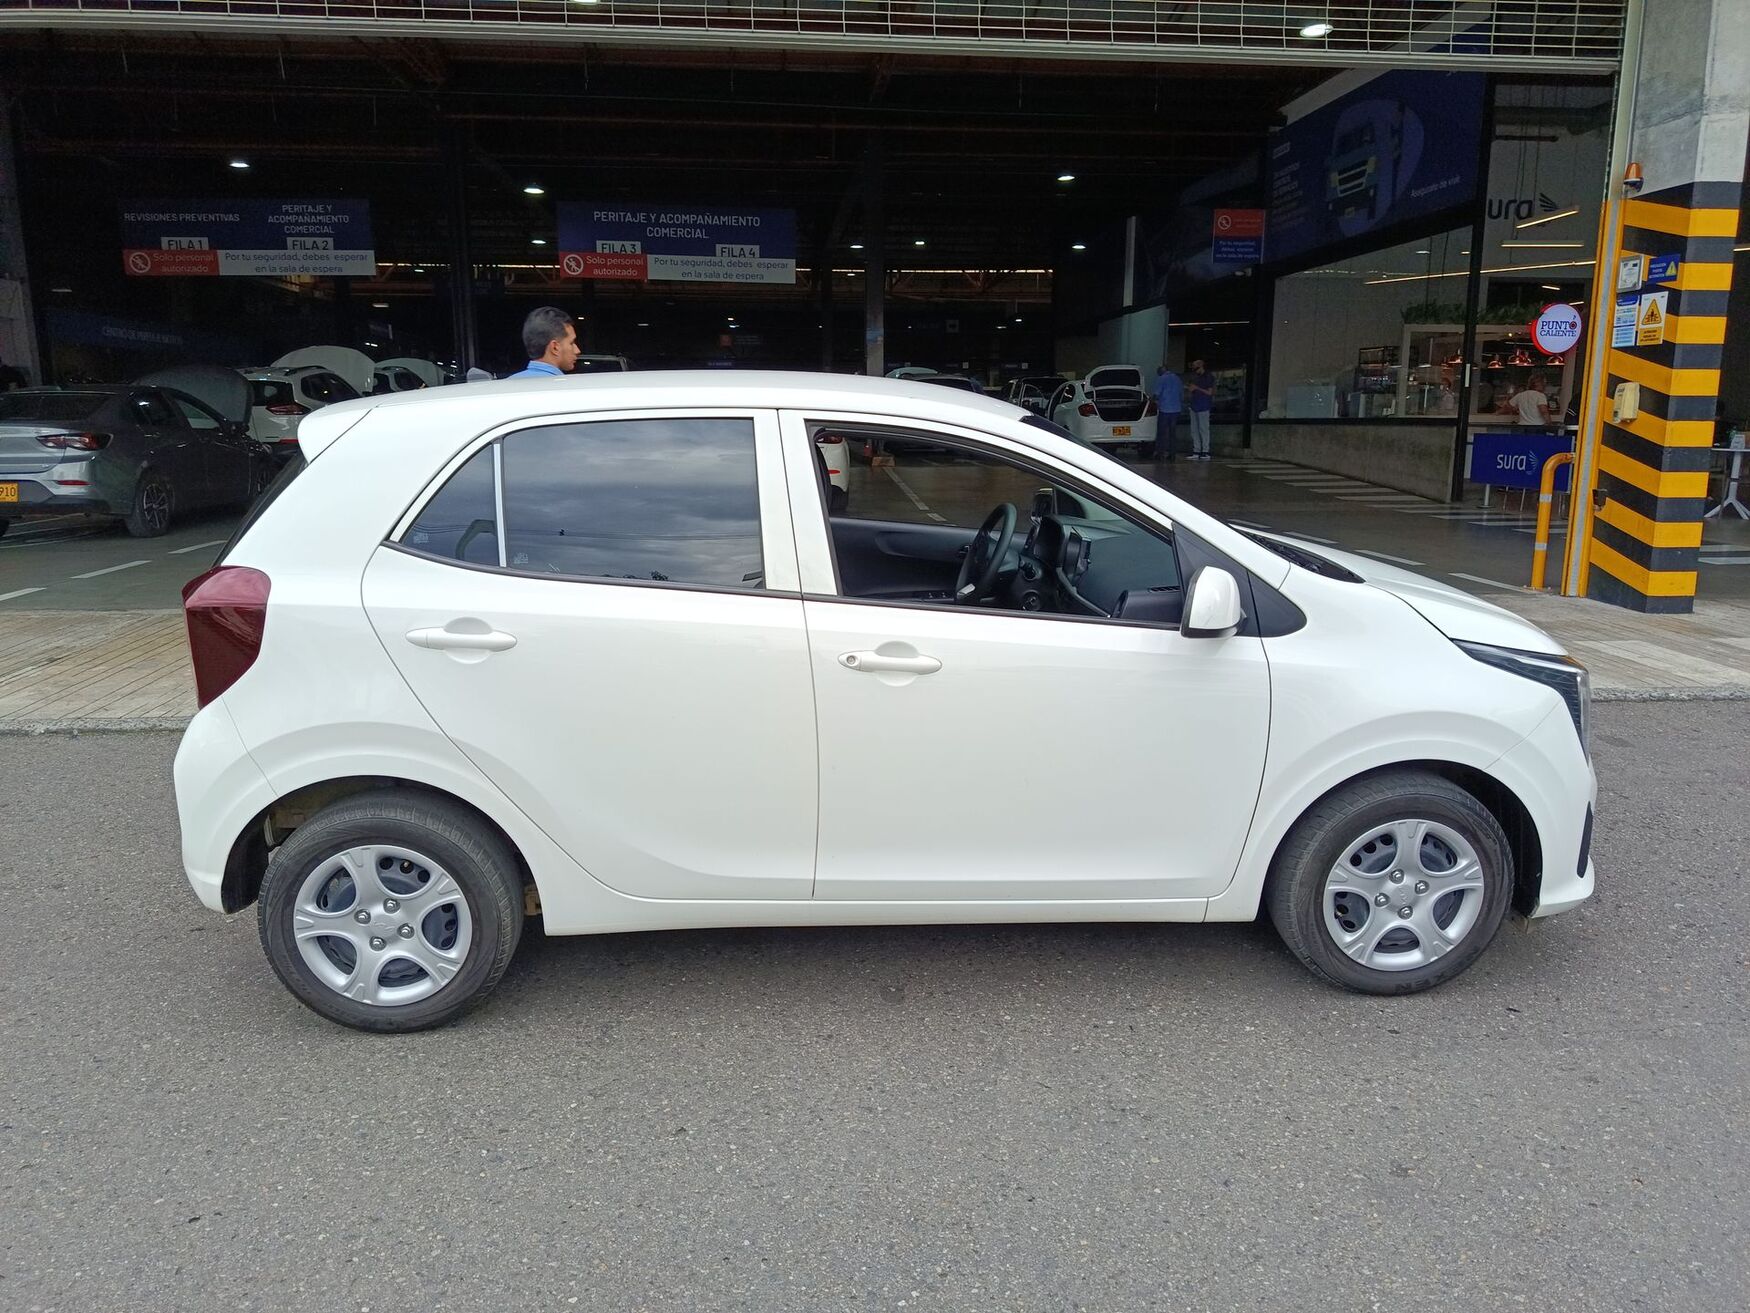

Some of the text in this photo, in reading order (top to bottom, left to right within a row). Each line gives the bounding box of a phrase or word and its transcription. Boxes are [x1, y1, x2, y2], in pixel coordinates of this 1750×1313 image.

[282, 204, 333, 213] PERITAJE Y
[1487, 199, 1533, 220] ura
[123, 212, 241, 222] REVISIONES PREVENTIVAS
[268, 213, 350, 224] ACOMPAÑAMIENTO
[593, 210, 761, 227] PERITAJE Y ACOMPAÑAMIENTO
[284, 225, 336, 234] COMERCIAL
[646, 226, 710, 239] COMERCIAL
[167, 239, 195, 250] FILA
[292, 239, 329, 250] FILA 2
[601, 243, 637, 254] FILA 3
[225, 252, 240, 261] Por
[241, 253, 250, 261] tu
[302, 252, 330, 261] debes
[333, 253, 368, 263] esperar
[720, 246, 756, 258] FILA 4
[153, 253, 215, 263] Solo personal
[586, 255, 644, 267] Solo personal
[160, 264, 208, 273] autorizado
[255, 264, 343, 274] en la sala de espera
[654, 257, 788, 271] Por tu seguridad, debes esperar
[593, 267, 638, 276] autorizado
[681, 269, 764, 281] en la sala de espera
[1540, 320, 1577, 330] PUNTO
[1496, 453, 1527, 471] sura
